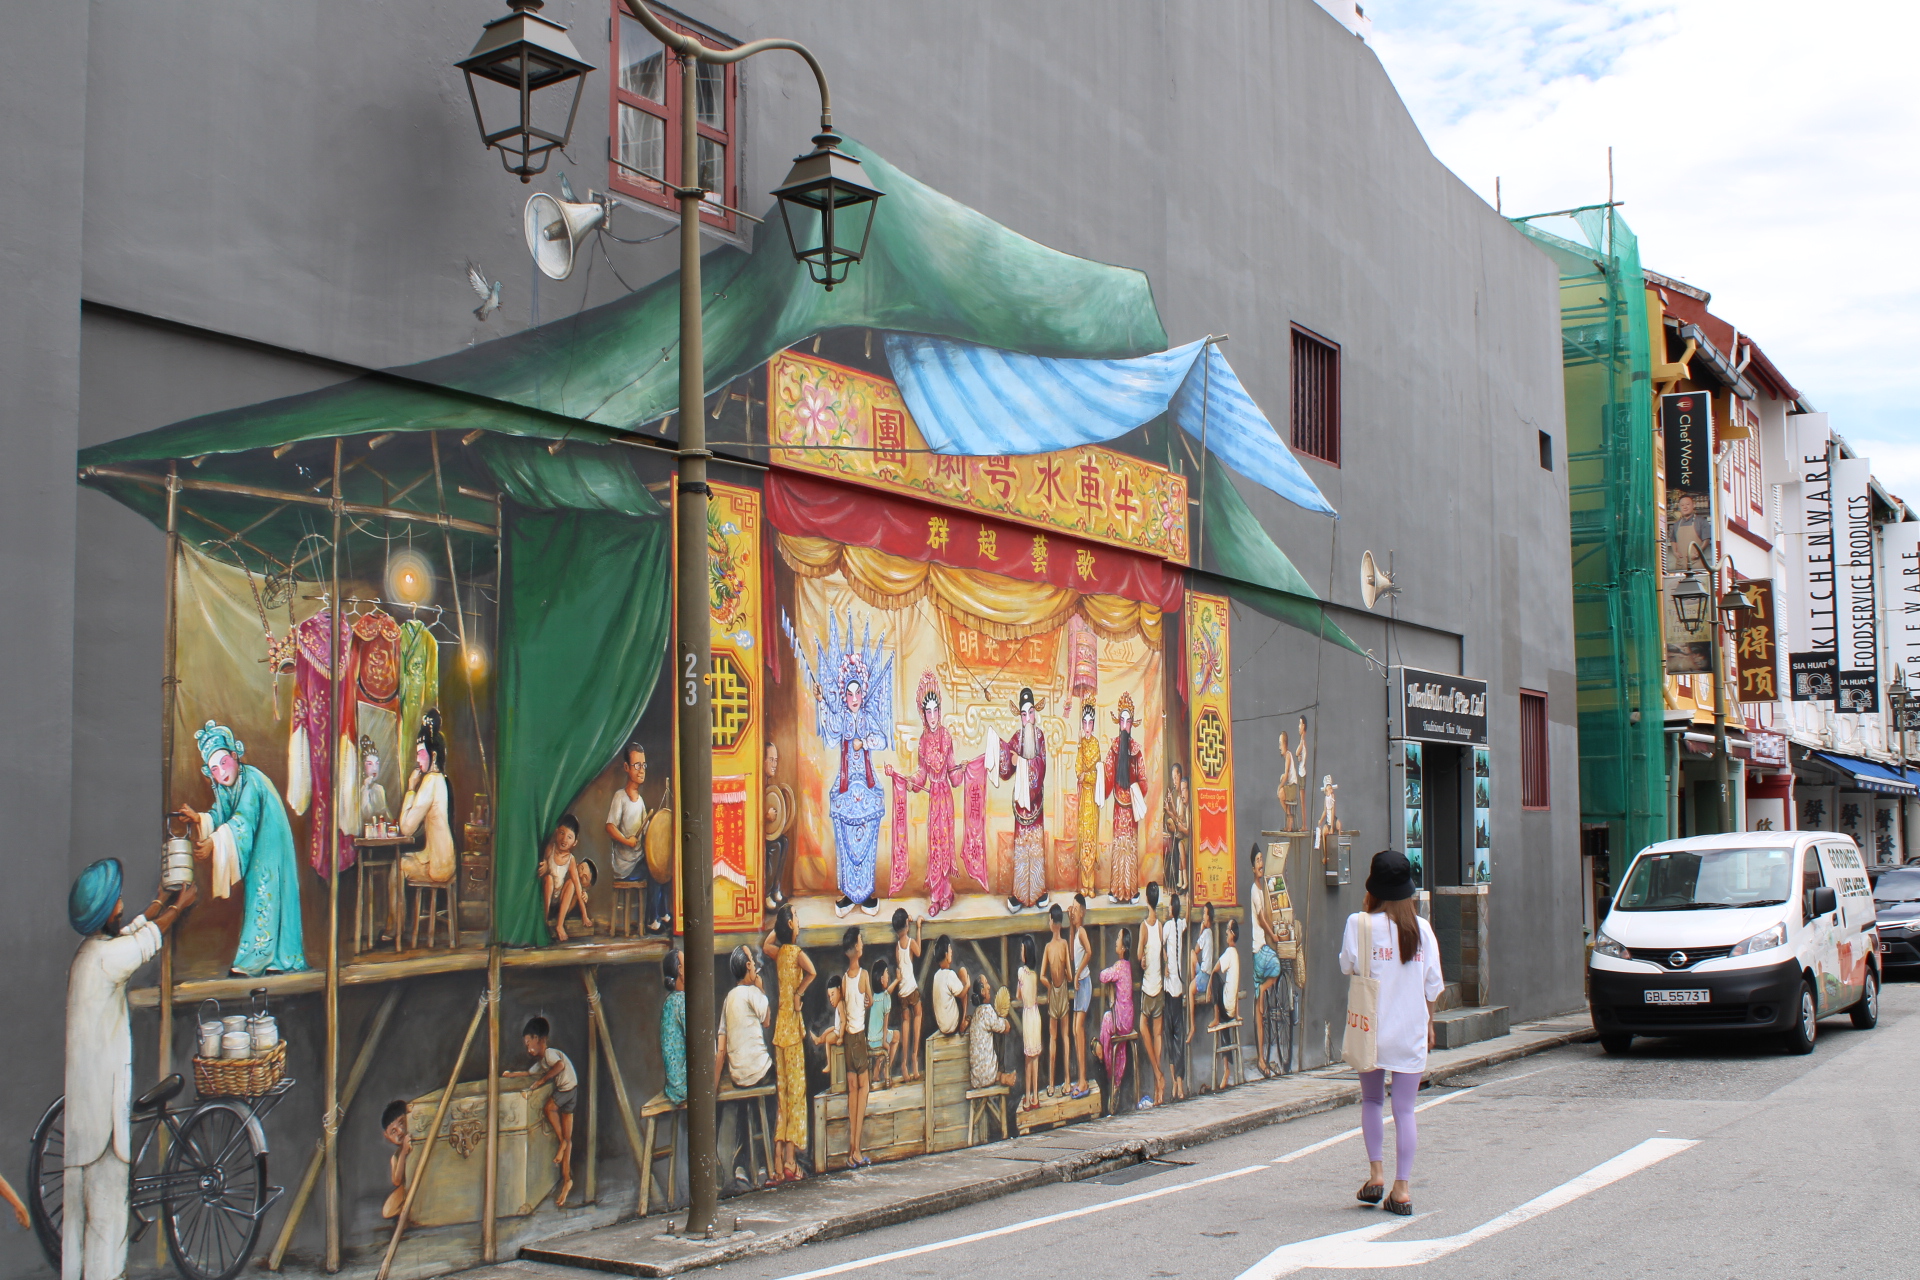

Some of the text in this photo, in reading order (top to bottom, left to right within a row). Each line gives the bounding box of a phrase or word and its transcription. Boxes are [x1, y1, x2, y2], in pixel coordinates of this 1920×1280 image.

[1679, 414, 1693, 485] Chef Works
[1804, 453, 1836, 650] KITCHENWARE
[1848, 495, 1875, 668] FOODSERVICE PRODUCTS
[685, 652, 697, 706] 23
[1792, 661, 1828, 670] SIA HUAT
[1849, 678, 1867, 686] HUAT
[1407, 682, 1486, 717] Healthland Pte Ltd
[1720, 783, 1727, 802] 21
[1827, 847, 1861, 869] GOODNESS
[1645, 990, 1708, 1002] GBL5573T
